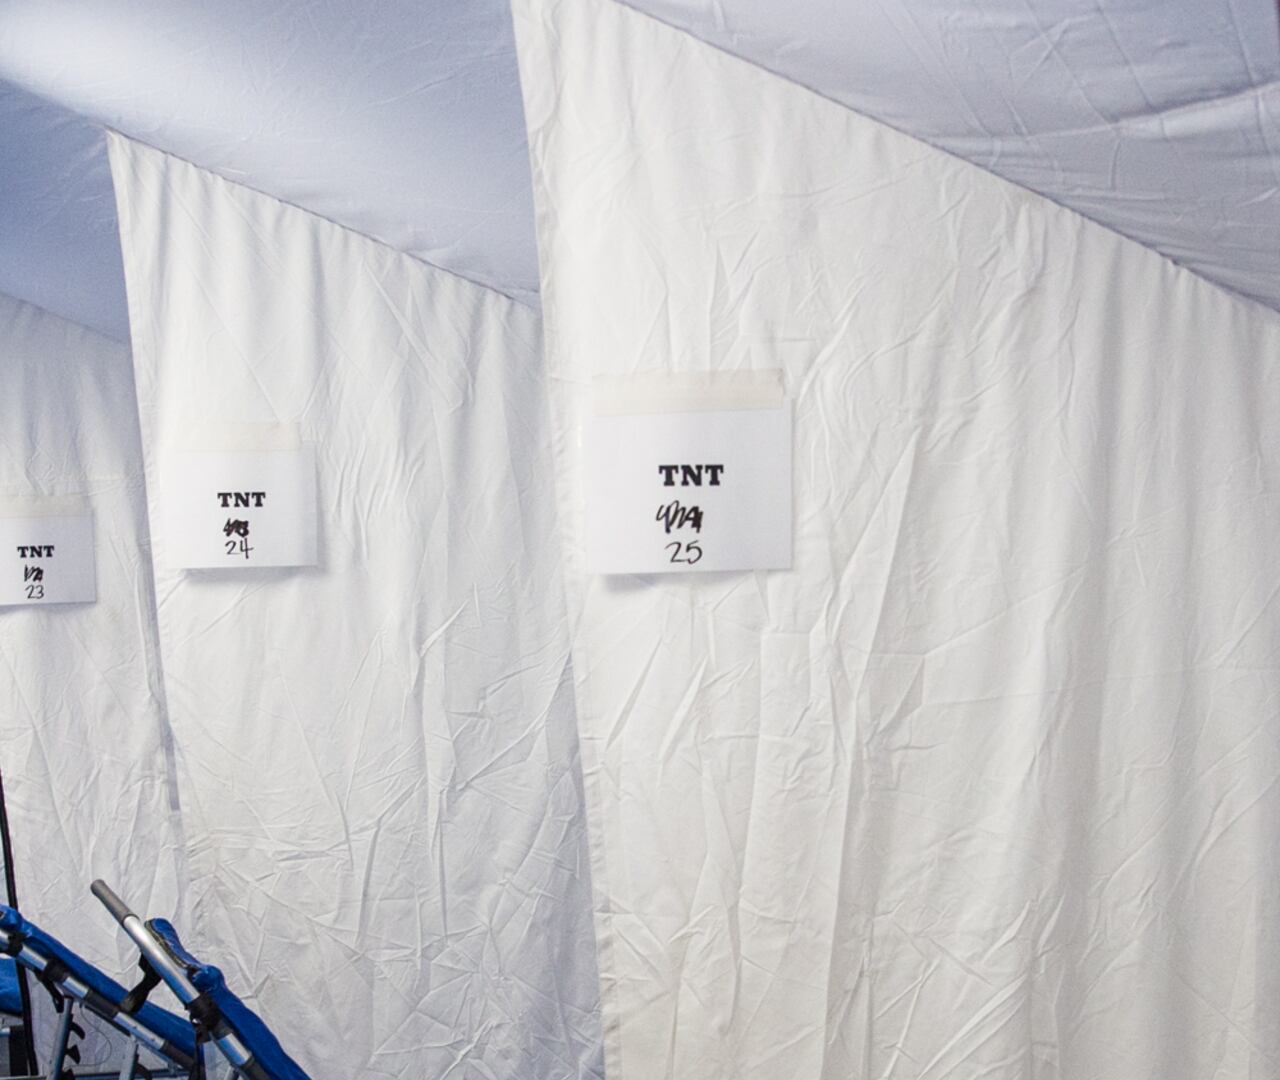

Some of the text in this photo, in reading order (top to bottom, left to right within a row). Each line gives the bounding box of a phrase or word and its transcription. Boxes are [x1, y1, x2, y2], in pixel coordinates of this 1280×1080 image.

[658, 464, 724, 486] TNT
[217, 492, 266, 508] TNT
[16, 545, 55, 558] TNT
[224, 537, 254, 560] 24
[664, 540, 703, 564] 25
[24, 584, 44, 600] 23
